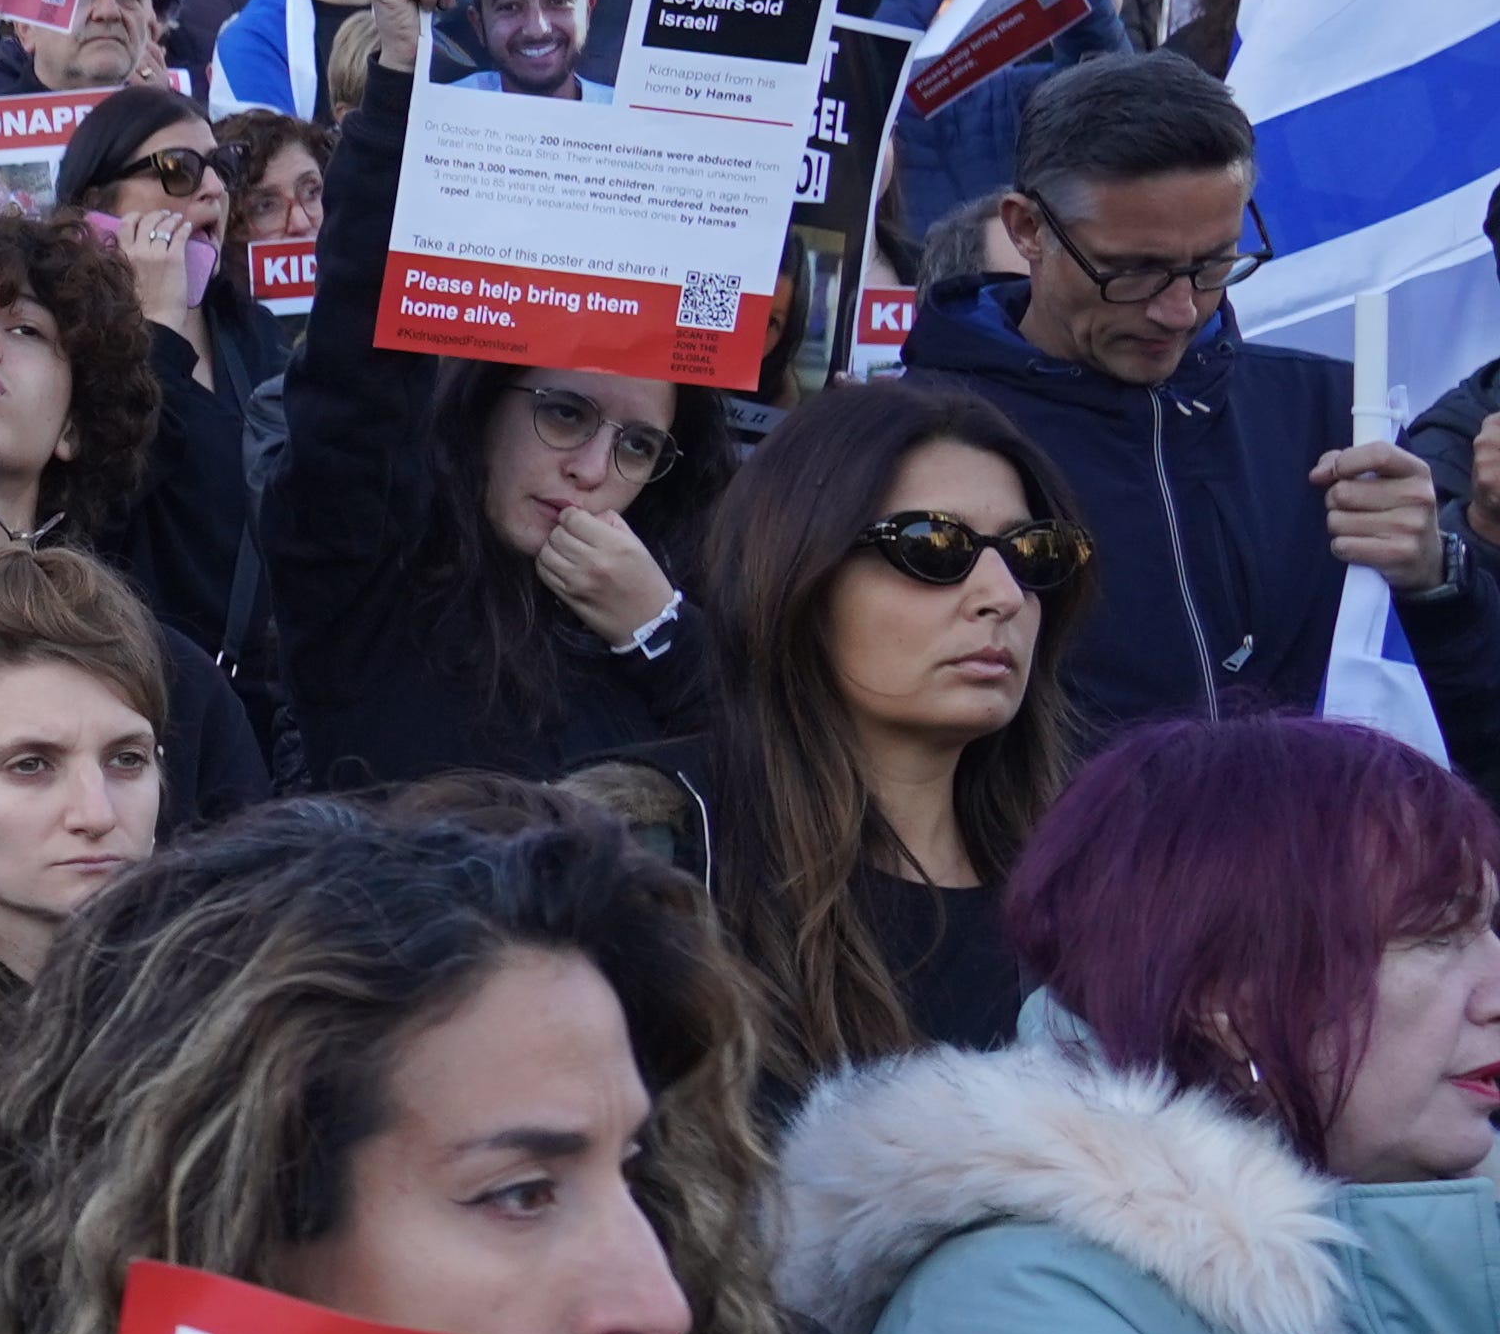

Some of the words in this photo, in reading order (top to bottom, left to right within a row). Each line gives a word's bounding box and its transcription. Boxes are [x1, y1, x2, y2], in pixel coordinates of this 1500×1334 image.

[658, 9, 718, 33] Israeli
[684, 85, 702, 101] by
[706, 87, 752, 105] Hamas
[811, 101, 850, 145] GEL
[539, 135, 559, 146] 200
[562, 138, 612, 153] innocent
[616, 143, 662, 159] civilians
[666, 151, 694, 162] were
[697, 154, 752, 169] abducted
[405, 269, 472, 296] Please
[479, 278, 522, 304] help
[527, 284, 581, 312] bring
[587, 291, 639, 315] them
[401, 296, 458, 321] home
[463, 306, 516, 328] alive.
